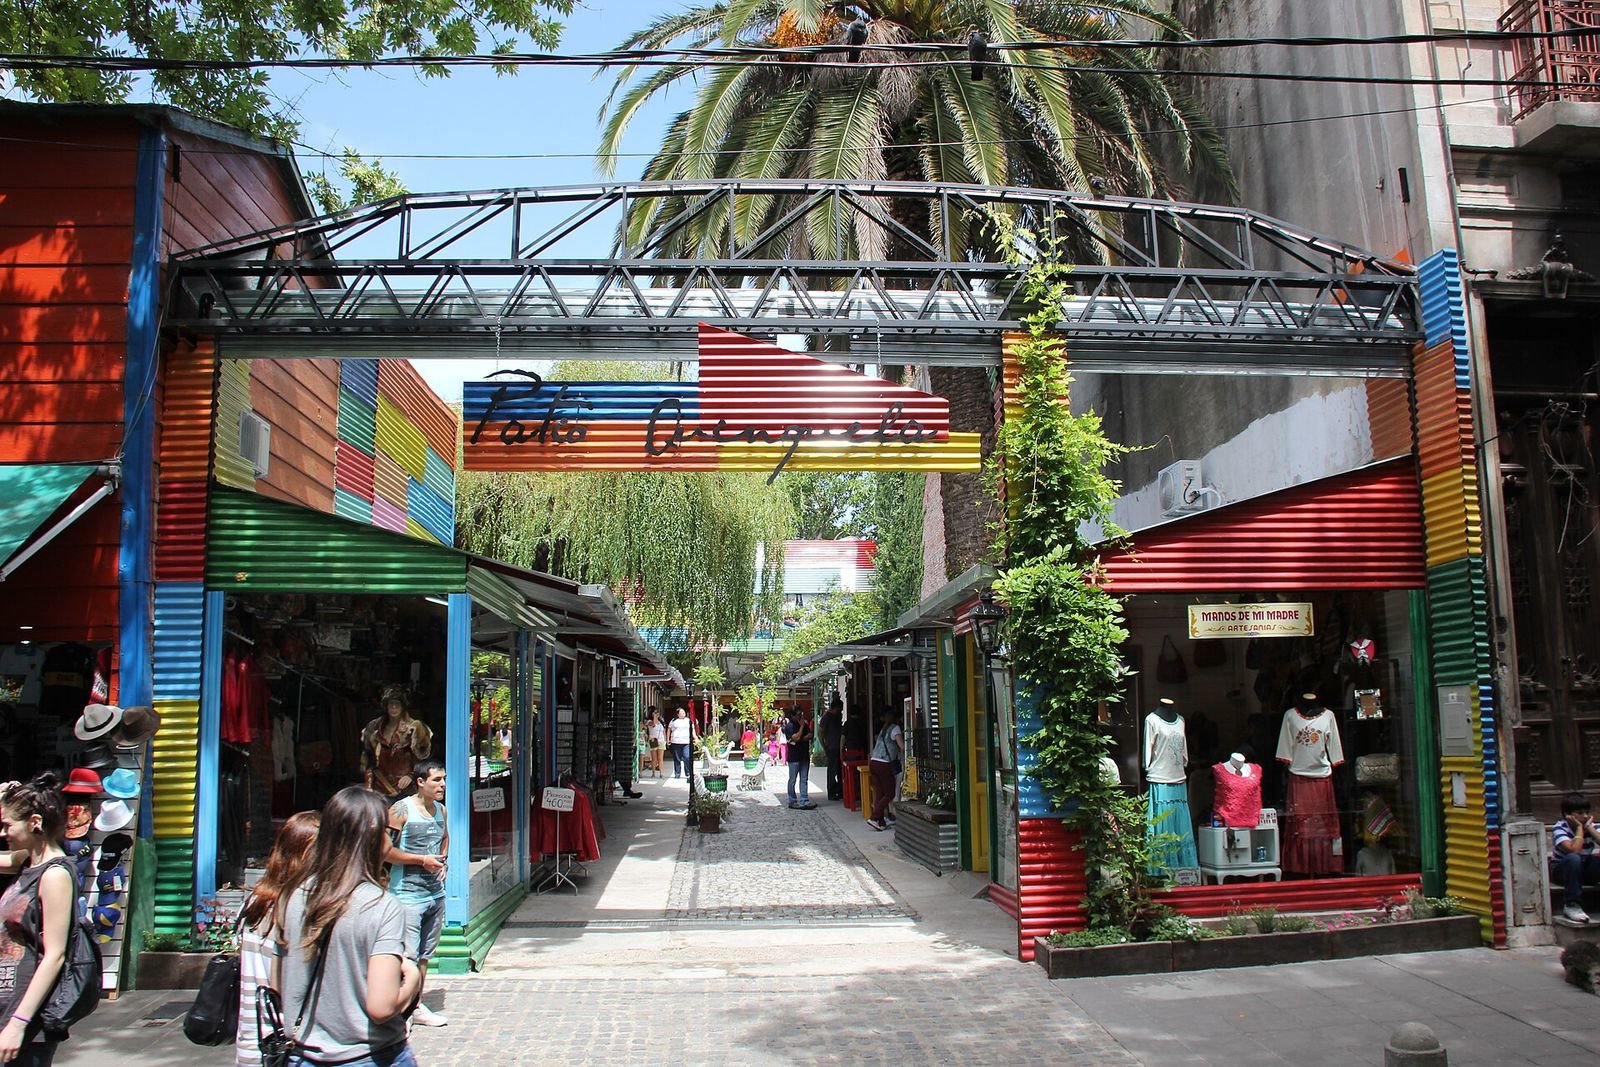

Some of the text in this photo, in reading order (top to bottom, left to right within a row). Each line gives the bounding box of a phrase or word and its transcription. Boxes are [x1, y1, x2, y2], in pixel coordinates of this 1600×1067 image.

[470, 369, 938, 486] Patio Quinquela
[1201, 610, 1299, 621] MANOS DE MI MADRE
[1227, 624, 1277, 632] ARTESANIAS
